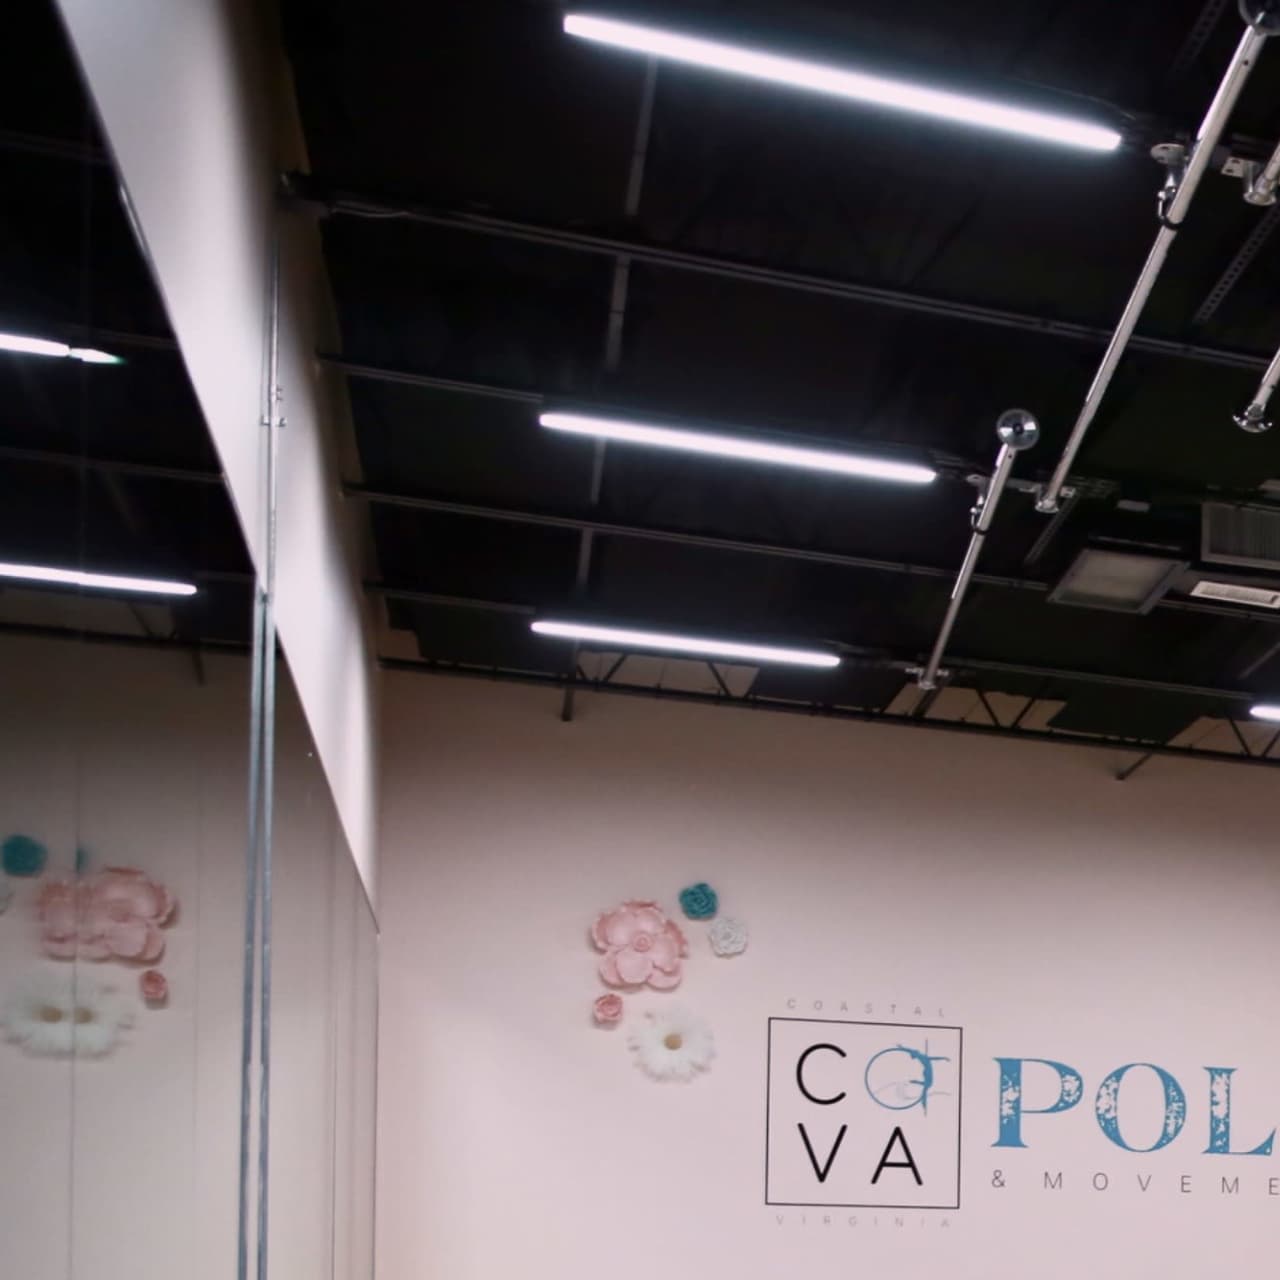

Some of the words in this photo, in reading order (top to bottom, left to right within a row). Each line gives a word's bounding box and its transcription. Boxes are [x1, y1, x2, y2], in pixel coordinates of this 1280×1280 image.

[786, 998, 945, 1018] COASTAL
[797, 1122, 924, 1187] VA
[991, 1169, 1006, 1189] &
[775, 1215, 951, 1228] VIRGINIA
